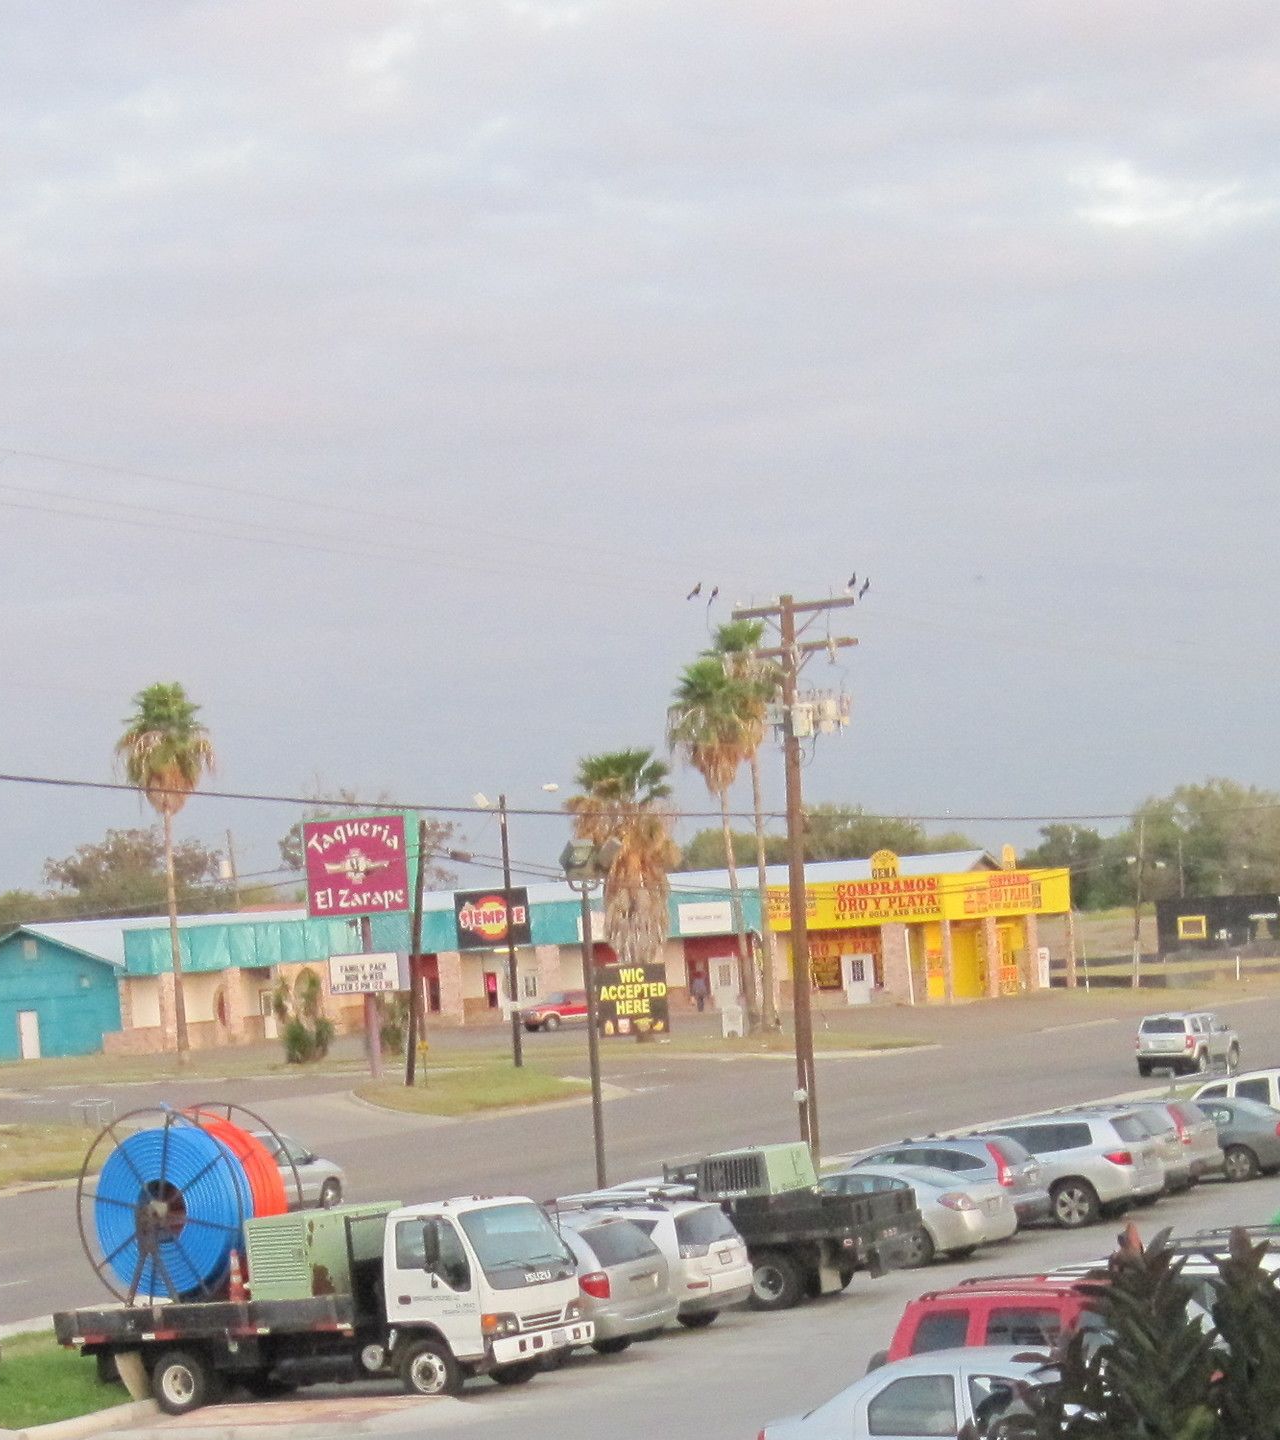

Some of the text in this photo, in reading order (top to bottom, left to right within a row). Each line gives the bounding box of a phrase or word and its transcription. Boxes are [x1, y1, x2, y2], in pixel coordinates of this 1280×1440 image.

[307, 821, 399, 854] Taqueria
[837, 877, 938, 898] COMPRAMOS
[314, 887, 404, 910] El Zarape
[837, 894, 938, 913] ORO Y PLATA
[459, 905, 526, 930] SIEMPE
[893, 908, 909, 917] AND
[619, 968, 645, 983] WIC
[600, 982, 667, 1001] ACCEPTED
[616, 999, 650, 1015] HERE
[524, 1269, 552, 1283] ISUZU
